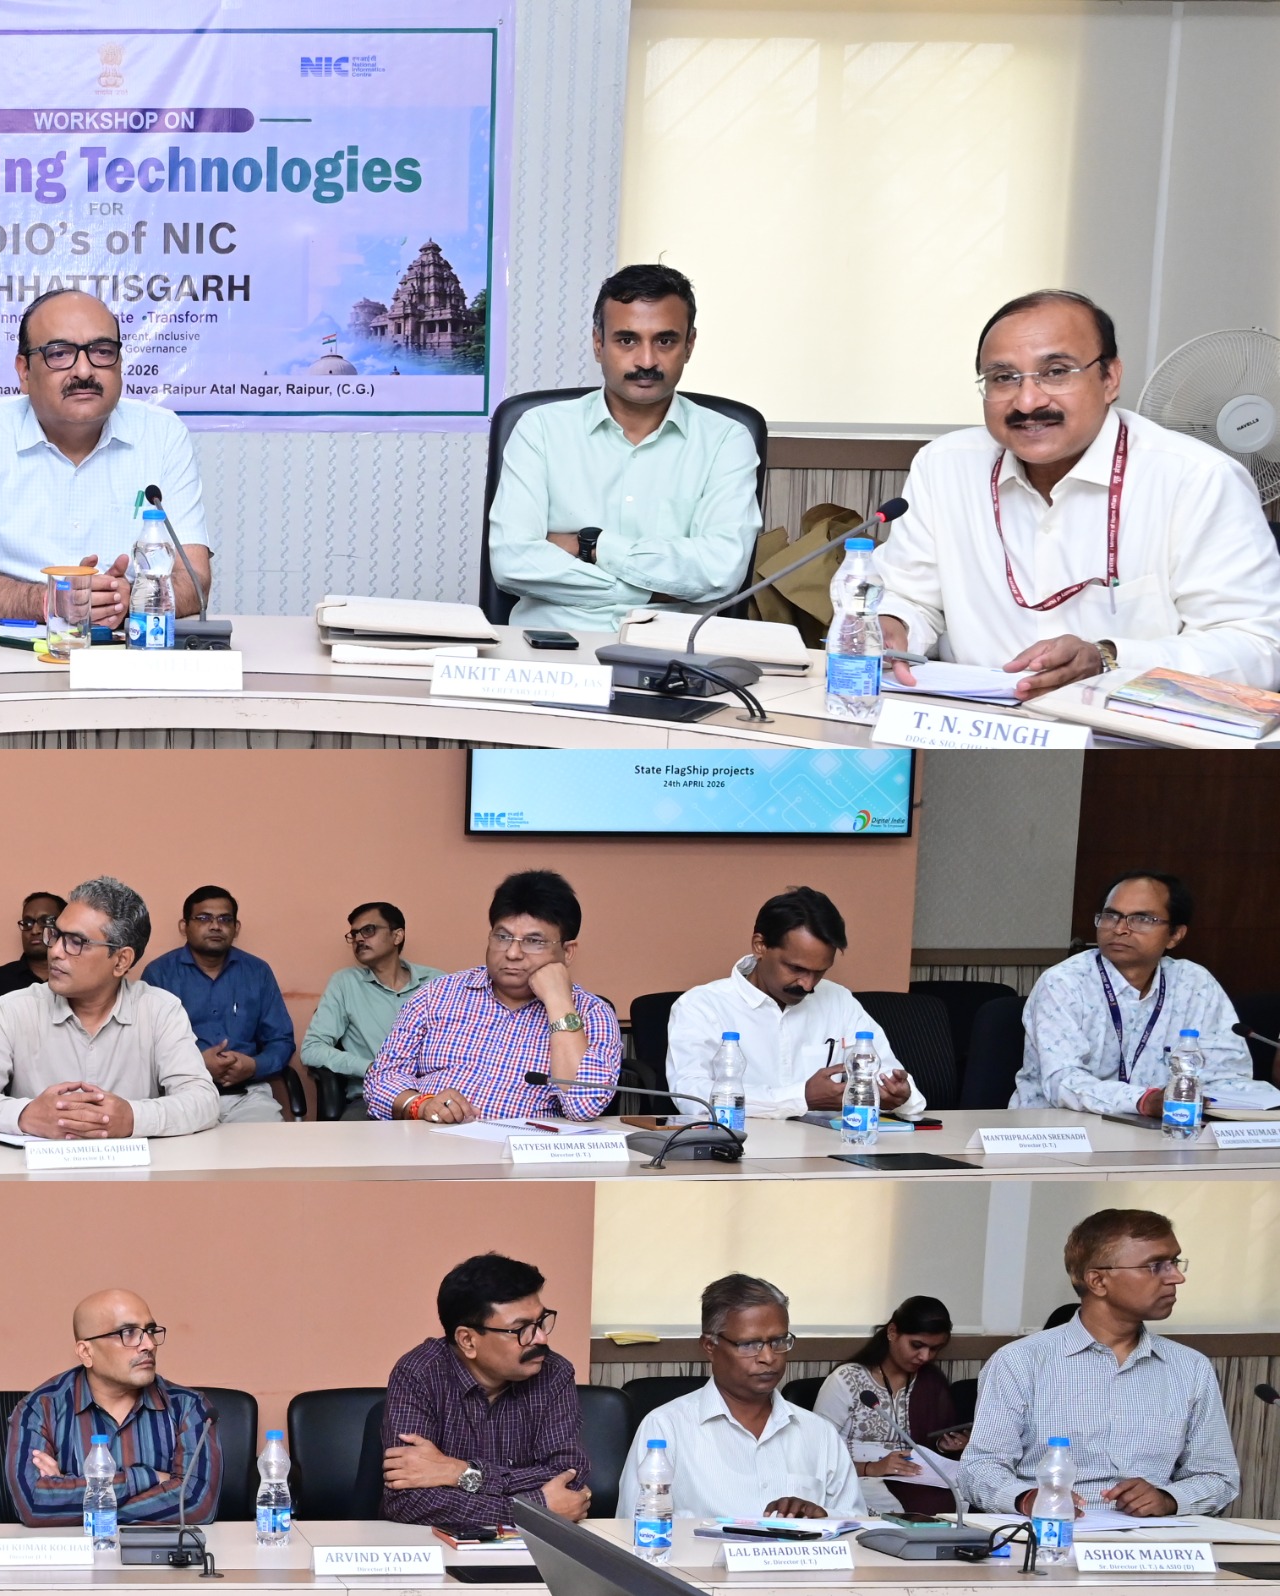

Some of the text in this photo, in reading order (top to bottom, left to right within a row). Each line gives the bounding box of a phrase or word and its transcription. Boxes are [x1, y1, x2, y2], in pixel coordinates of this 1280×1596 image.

[300, 56, 349, 78] NIC
[33, 111, 195, 130] WORKSHOP ON
[79, 144, 423, 204] Technologies
[89, 202, 124, 216] FOR
[106, 220, 148, 255] of
[163, 222, 237, 255] NIC
[154, 331, 201, 341] Inclusive
[125, 344, 188, 354] Governance
[126, 383, 375, 398] Nava Raipur Atal Nagar, Raipur, (C.G.)
[440, 664, 501, 682] ANKIT
[504, 667, 578, 688] ANAND,
[912, 711, 1051, 748] T. N. SINGH
[905, 734, 927, 744] DDG
[634, 764, 755, 778] State FlagShip projects
[663, 780, 726, 788] 24th APRIL 2026
[474, 812, 506, 828] NIC
[871, 817, 890, 825] Digital
[1048, 1133, 1087, 1141] SREENADH
[1214, 1127, 1278, 1139] SANJAY KUMAR
[29, 1143, 147, 1155] PANKAJ SAMUEL GAJBHIYE
[512, 1141, 625, 1152] SATYESH KUMAR SHARMA
[11, 1543, 48, 1552] KUMAR
[49, 1543, 91, 1552] KOCHAR
[728, 1545, 848, 1557] LAL BAHADUR SINGH
[325, 1552, 432, 1563] ARVIND YADAV
[1083, 1549, 1206, 1561] ASHOK MAURYA
